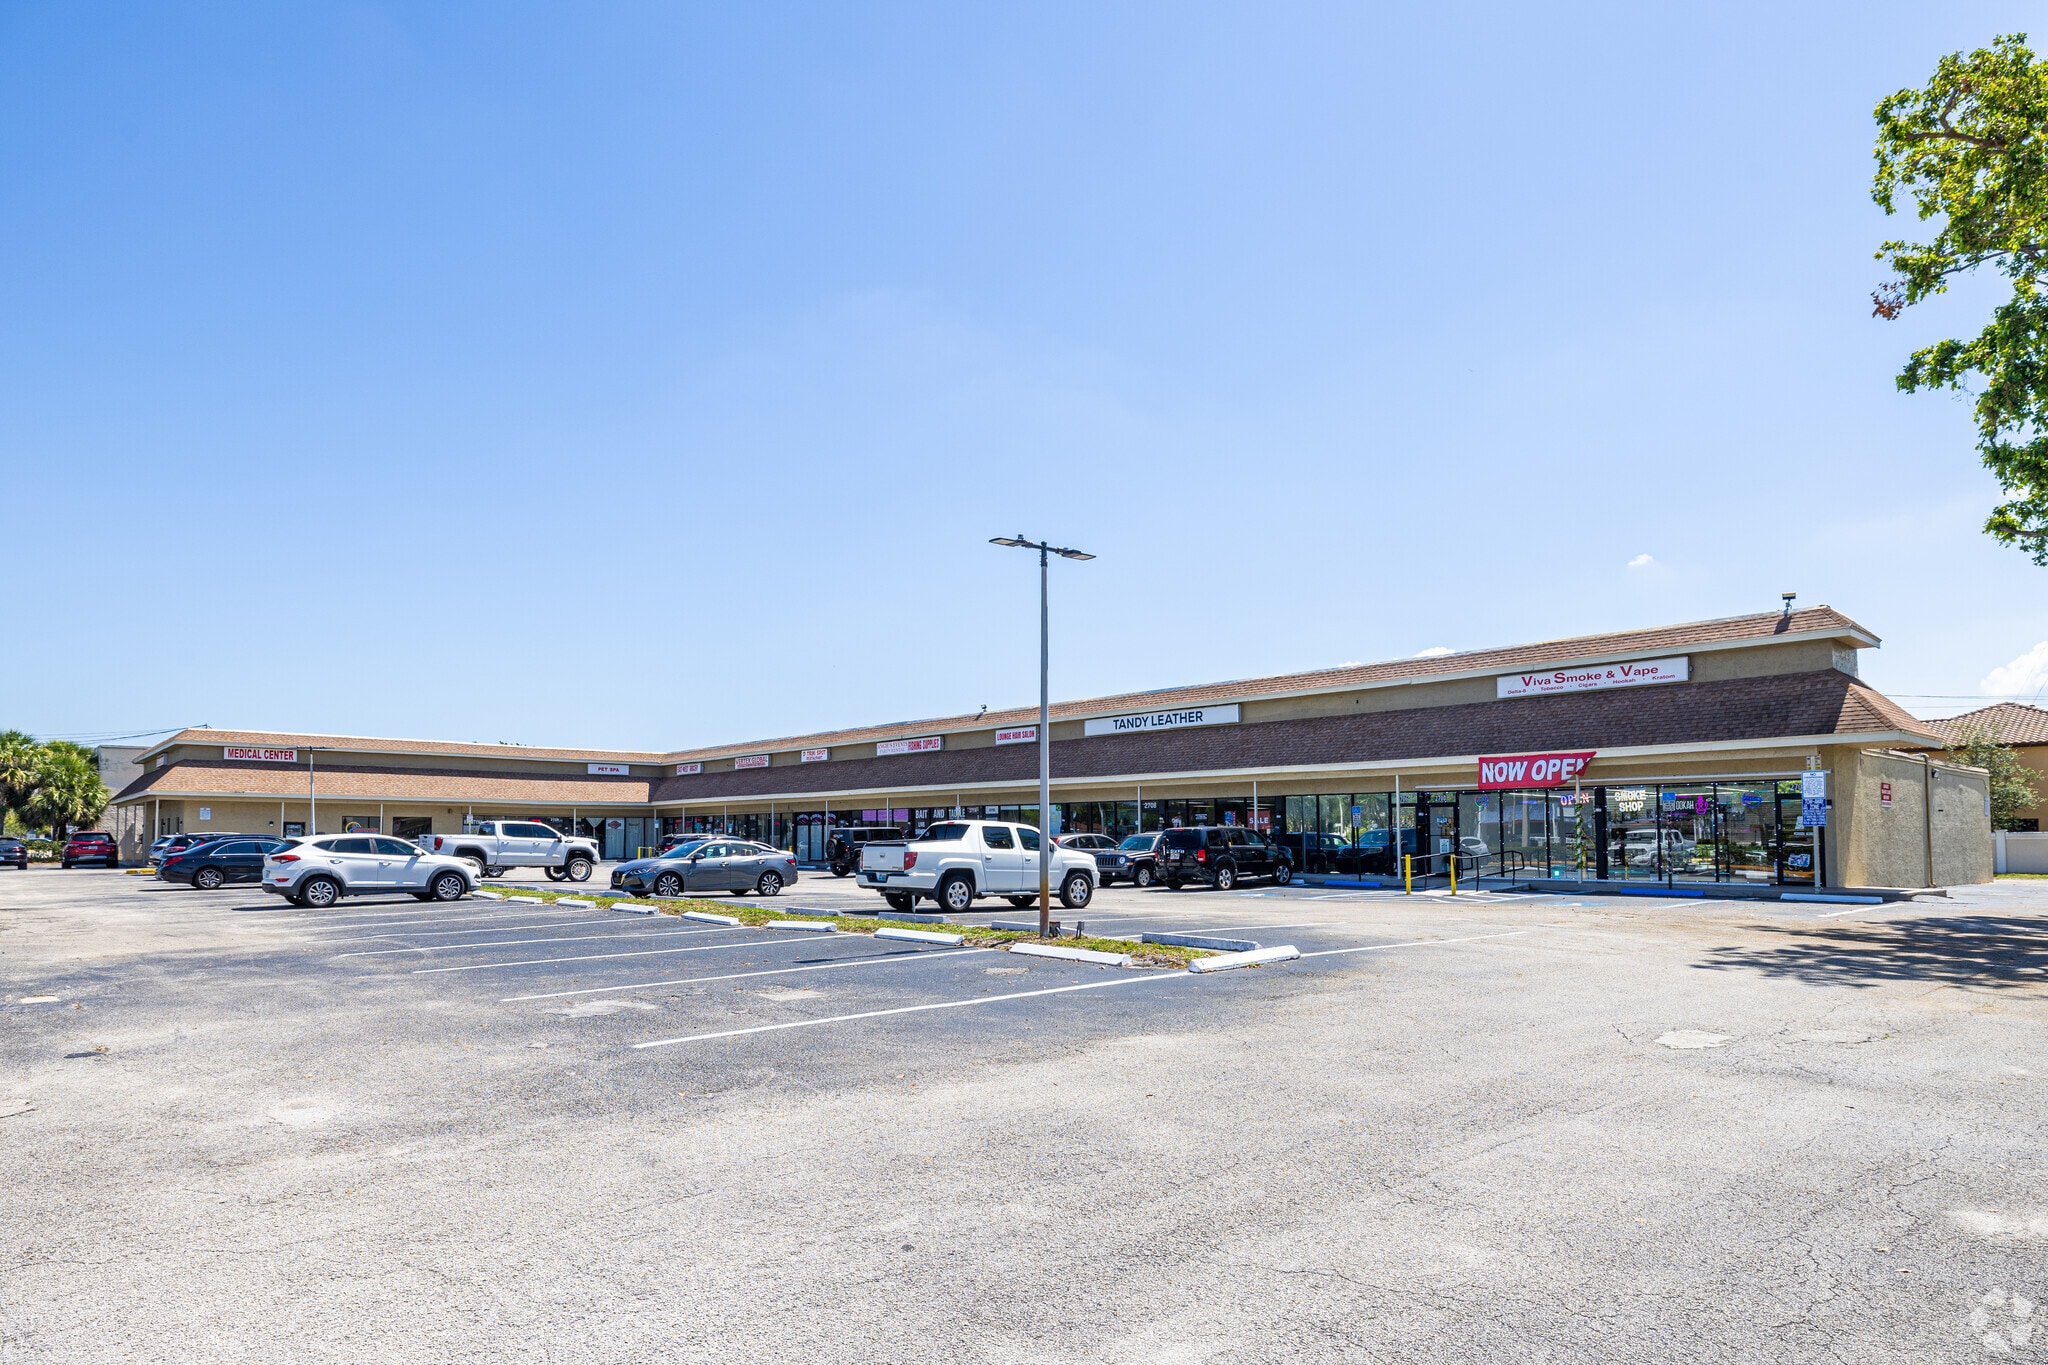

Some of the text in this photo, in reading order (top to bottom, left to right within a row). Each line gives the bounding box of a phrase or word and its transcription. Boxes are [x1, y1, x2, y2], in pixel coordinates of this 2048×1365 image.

[1521, 664, 1659, 687] Viva Smoke & Vape
[1652, 673, 1676, 681] Kratom
[1113, 710, 1204, 730] TANDY LEATHER
[997, 730, 1034, 741] LOUNGE HAIR SALON
[908, 738, 939, 751] FISHING SUPPLIES
[227, 748, 294, 761] MEDICAL CENTER
[1481, 761, 1528, 784] NOW
[1614, 789, 1646, 802] SMOKE
[1619, 800, 1644, 812] SHOP
[1675, 801, 1694, 810] OOKAH
[915, 809, 928, 819] BAIT
[933, 809, 945, 819] AND
